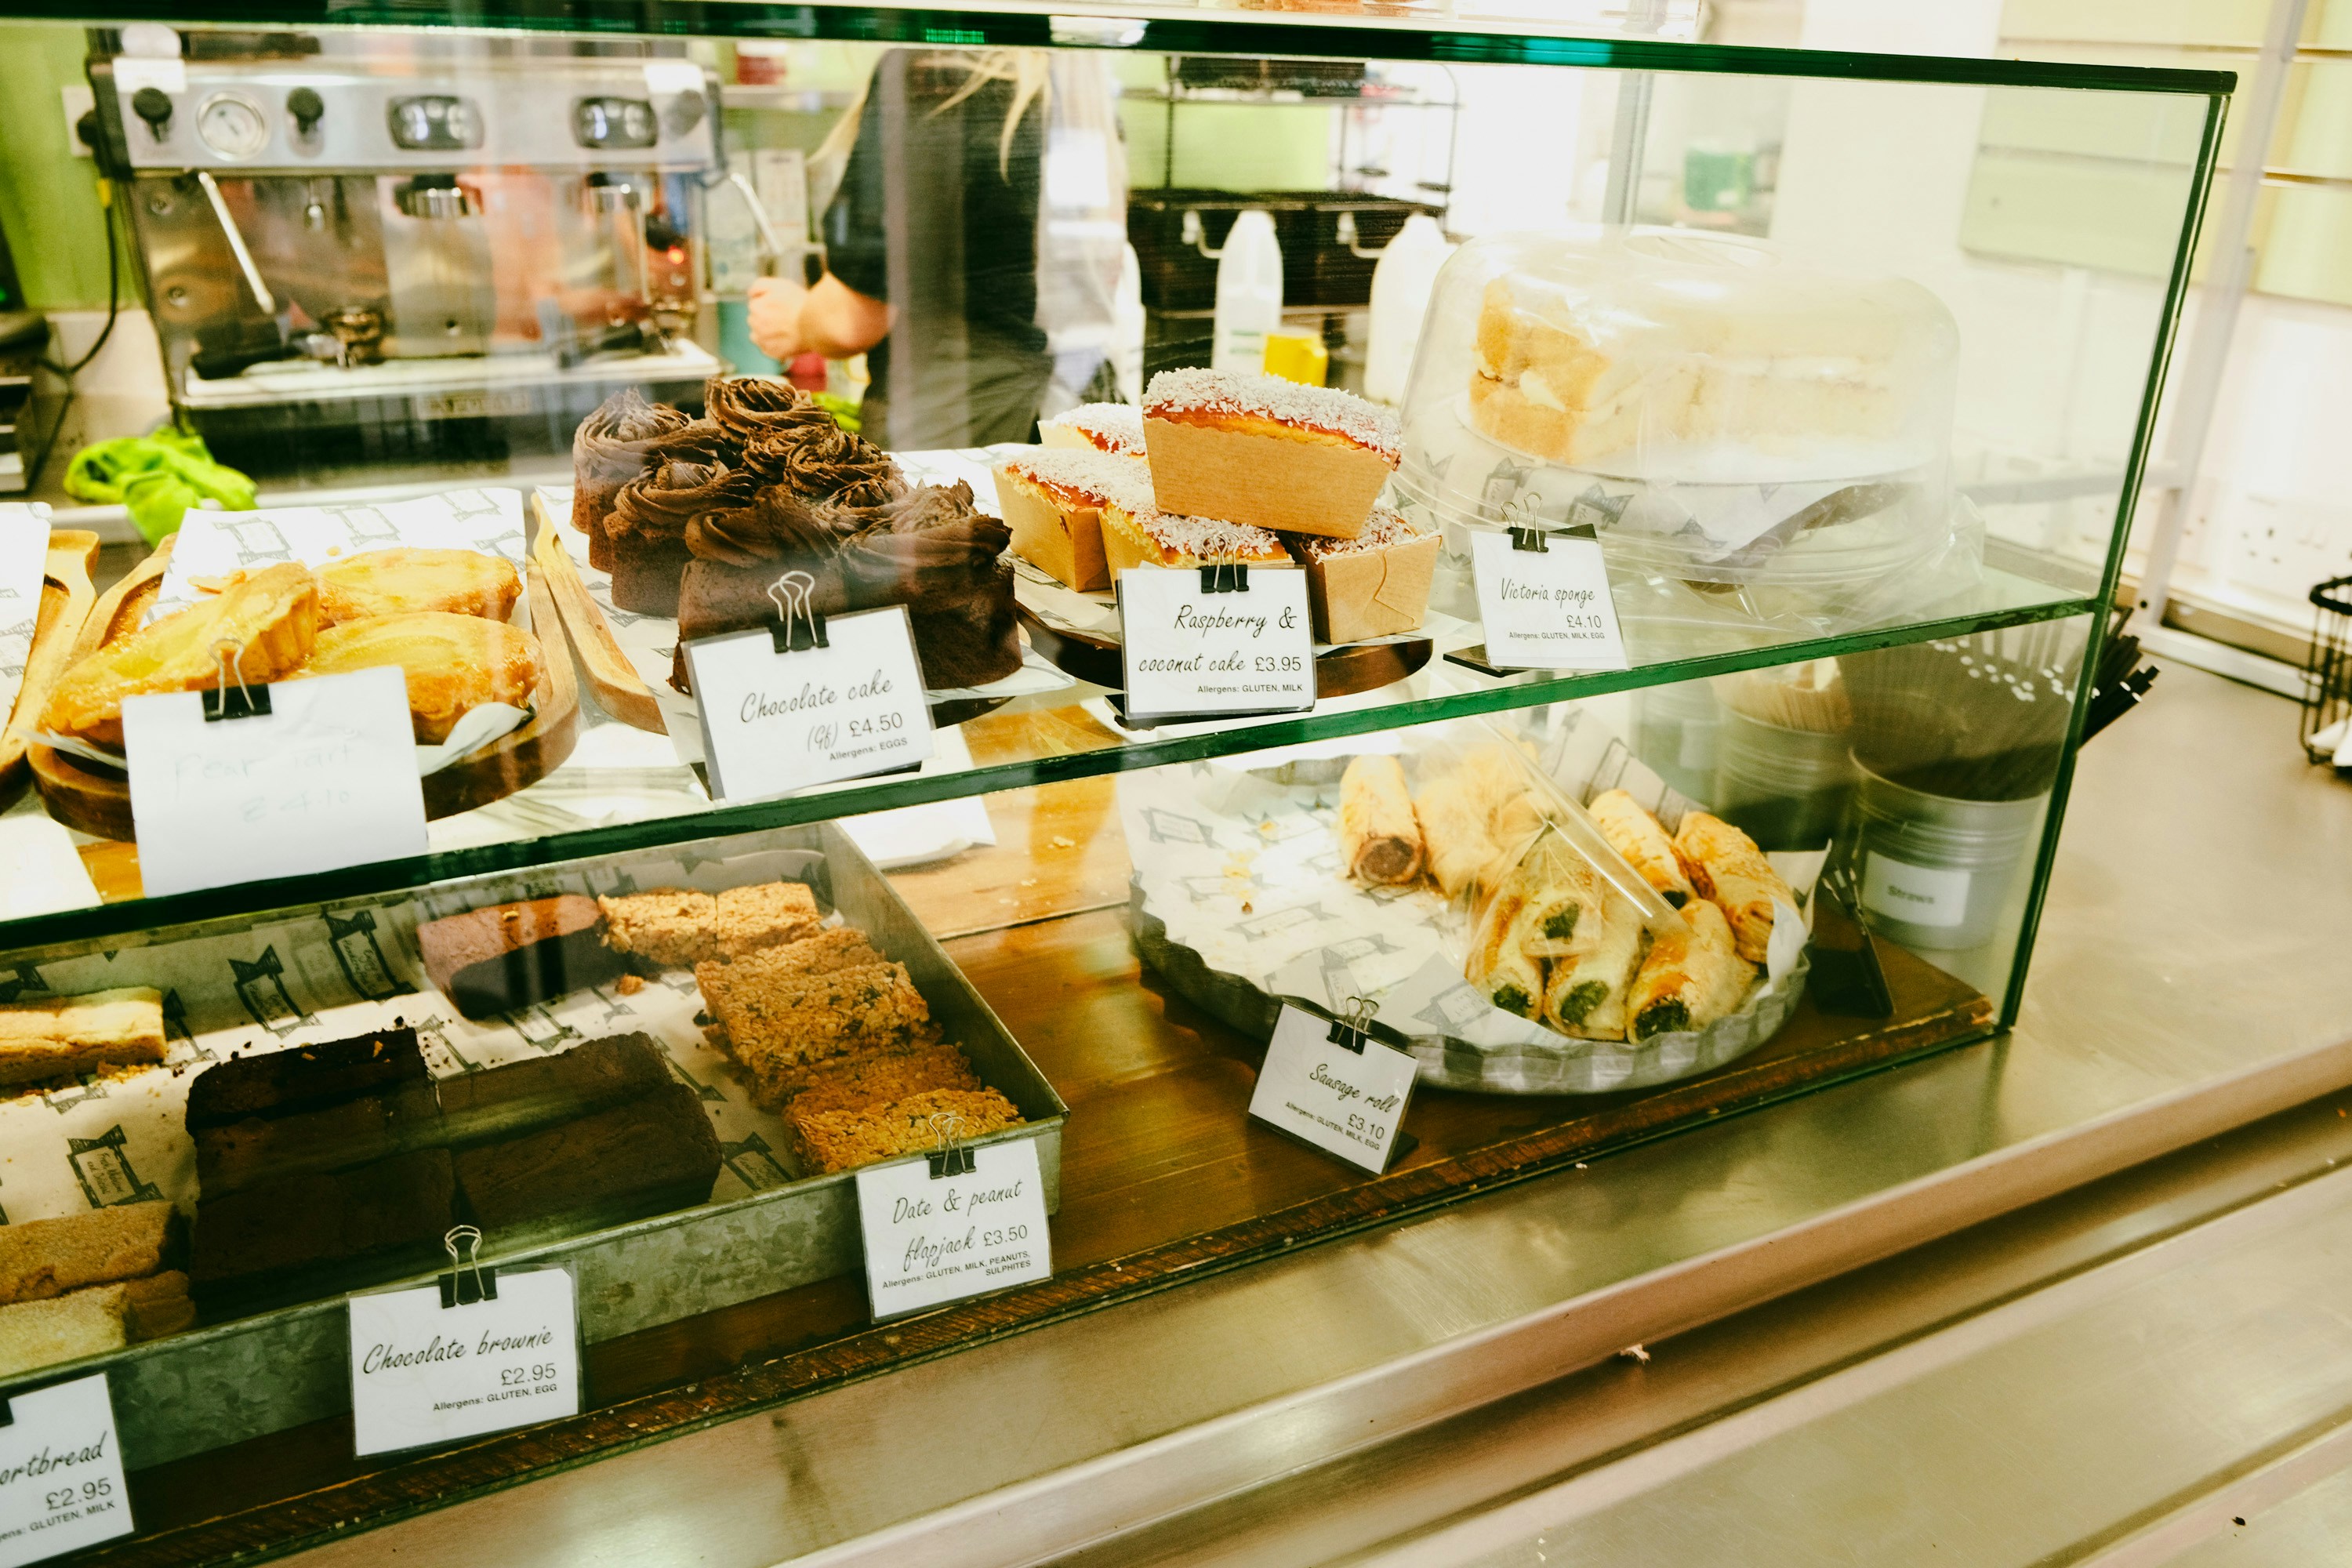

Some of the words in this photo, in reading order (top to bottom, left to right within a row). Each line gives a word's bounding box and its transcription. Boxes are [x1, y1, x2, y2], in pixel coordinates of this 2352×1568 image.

[1501, 578, 1549, 601] Victoria
[1555, 589, 1595, 609] sponge
[1174, 604, 1268, 638] Raspberry
[1278, 606, 1297, 629] &
[1566, 615, 1602, 628] £4.10
[1138, 652, 1204, 673] coconut
[1209, 650, 1246, 671] cake
[1254, 656, 1301, 672] £3.95
[740, 682, 838, 723] Chocolate
[848, 669, 893, 700] cake
[1197, 685, 1240, 695] Allergens:
[849, 712, 903, 738] £4.50
[829, 745, 877, 760] Allergens:
[880, 737, 908, 750] EGGS
[1309, 1063, 1361, 1101] Sausage
[1364, 1094, 1400, 1113] roll
[1316, 1116, 1344, 1134] GLUTEN,
[1364, 1138, 1380, 1151] EGG
[1347, 1113, 1385, 1140] £3.10
[892, 1196, 933, 1224] Date
[943, 1189, 962, 1212] &
[967, 1179, 1023, 1217] peanut
[902, 1225, 976, 1272] flapjack
[983, 1225, 1028, 1247] £3.50
[882, 1275, 924, 1290] Allergens:
[926, 1266, 964, 1279] GLUTEN,
[964, 1260, 987, 1271] MILK,
[989, 1250, 1031, 1265] PEANUTS,
[985, 1260, 1031, 1276] SULPHITES
[363, 1335, 466, 1374] Chocolate
[476, 1325, 554, 1356] brownie
[500, 1363, 557, 1386] £2.95
[433, 1396, 484, 1411] Allergens:
[487, 1388, 532, 1403] GLUTEN,
[535, 1384, 557, 1395] EGG
[45, 1477, 111, 1510] £2.95
[0, 1529, 25, 1543] ens:
[30, 1510, 83, 1531] GLUTEN,
[86, 1500, 115, 1515] MILK
